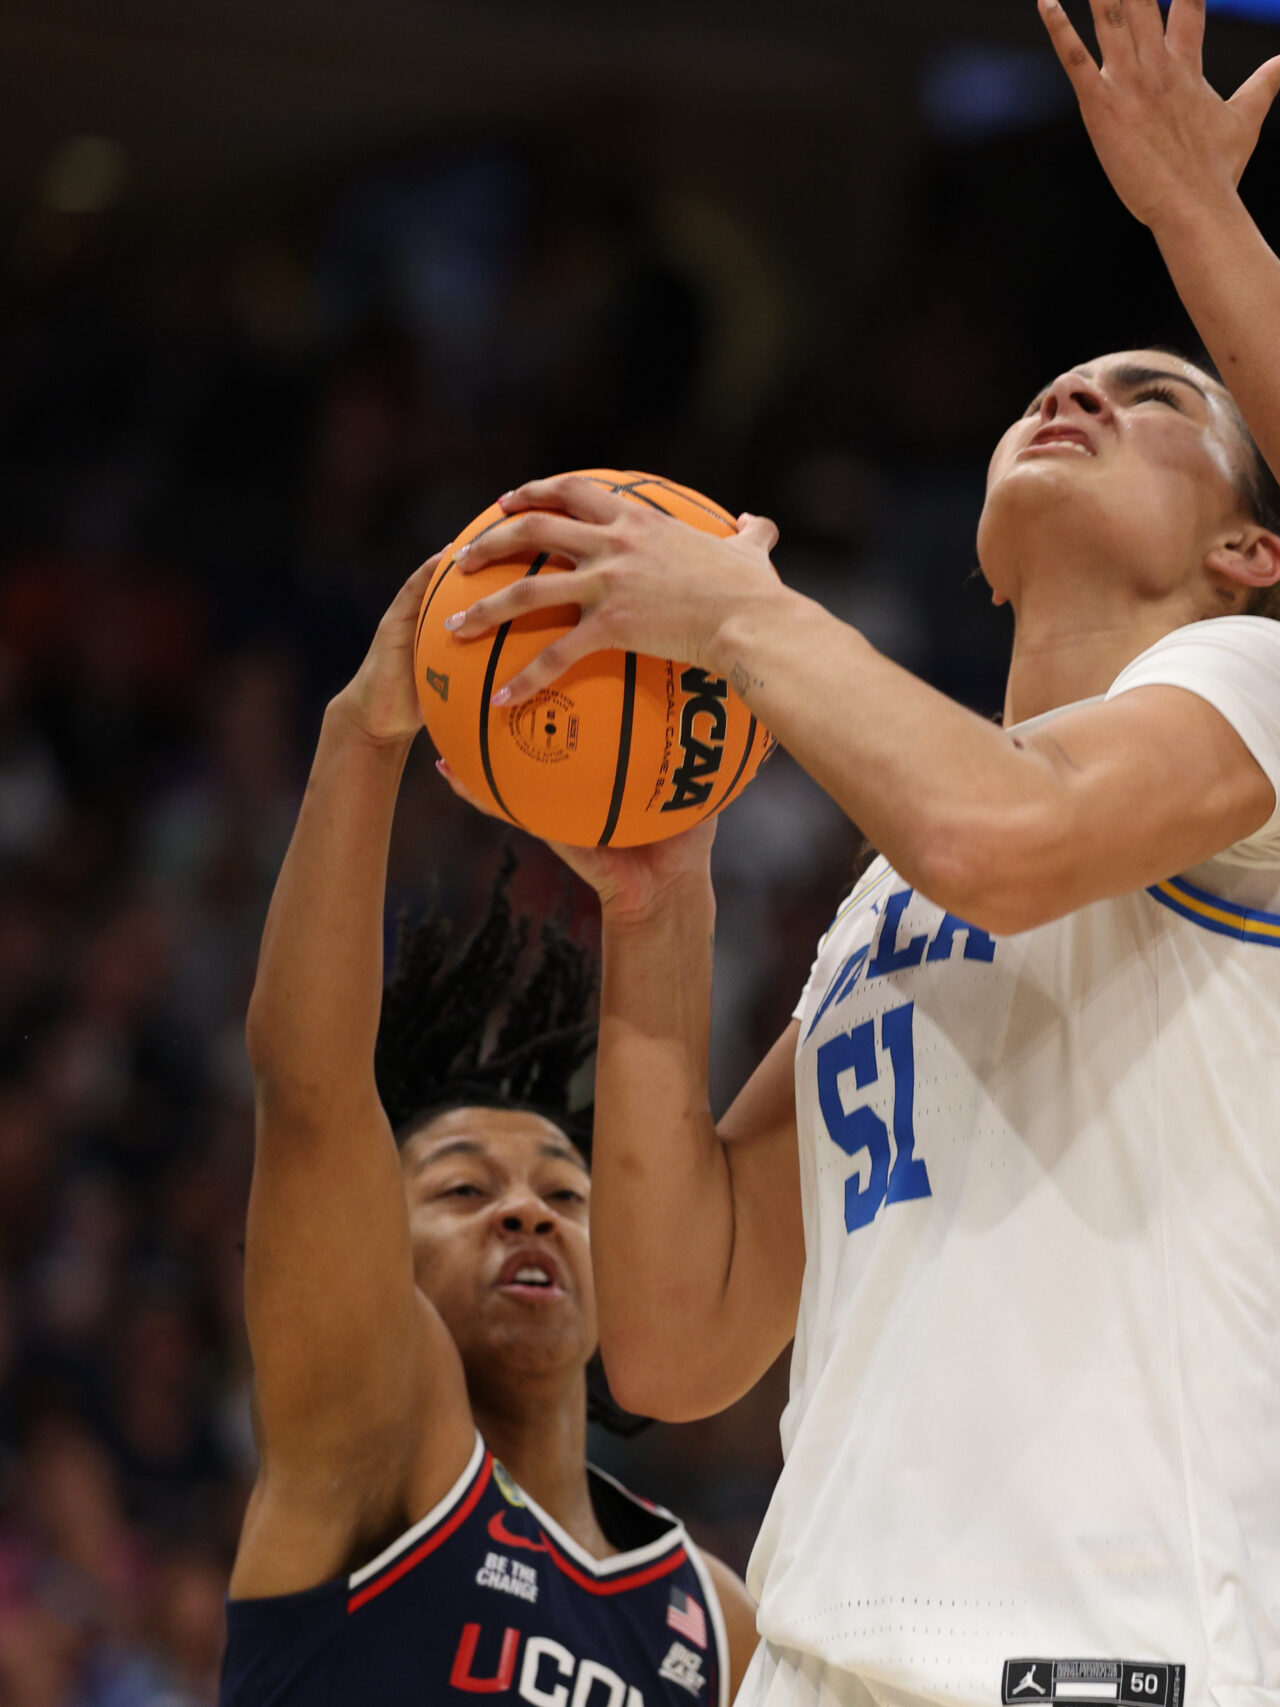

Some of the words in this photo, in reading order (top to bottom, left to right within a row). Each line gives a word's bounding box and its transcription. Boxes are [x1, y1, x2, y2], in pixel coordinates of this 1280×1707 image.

[817, 1001, 932, 1234] 51
[476, 1567, 539, 1604] CHANGE
[485, 1551, 509, 1572] BE
[511, 1560, 537, 1585] THE
[449, 1622, 645, 1707] UCO
[1130, 1671, 1158, 1695] 50
